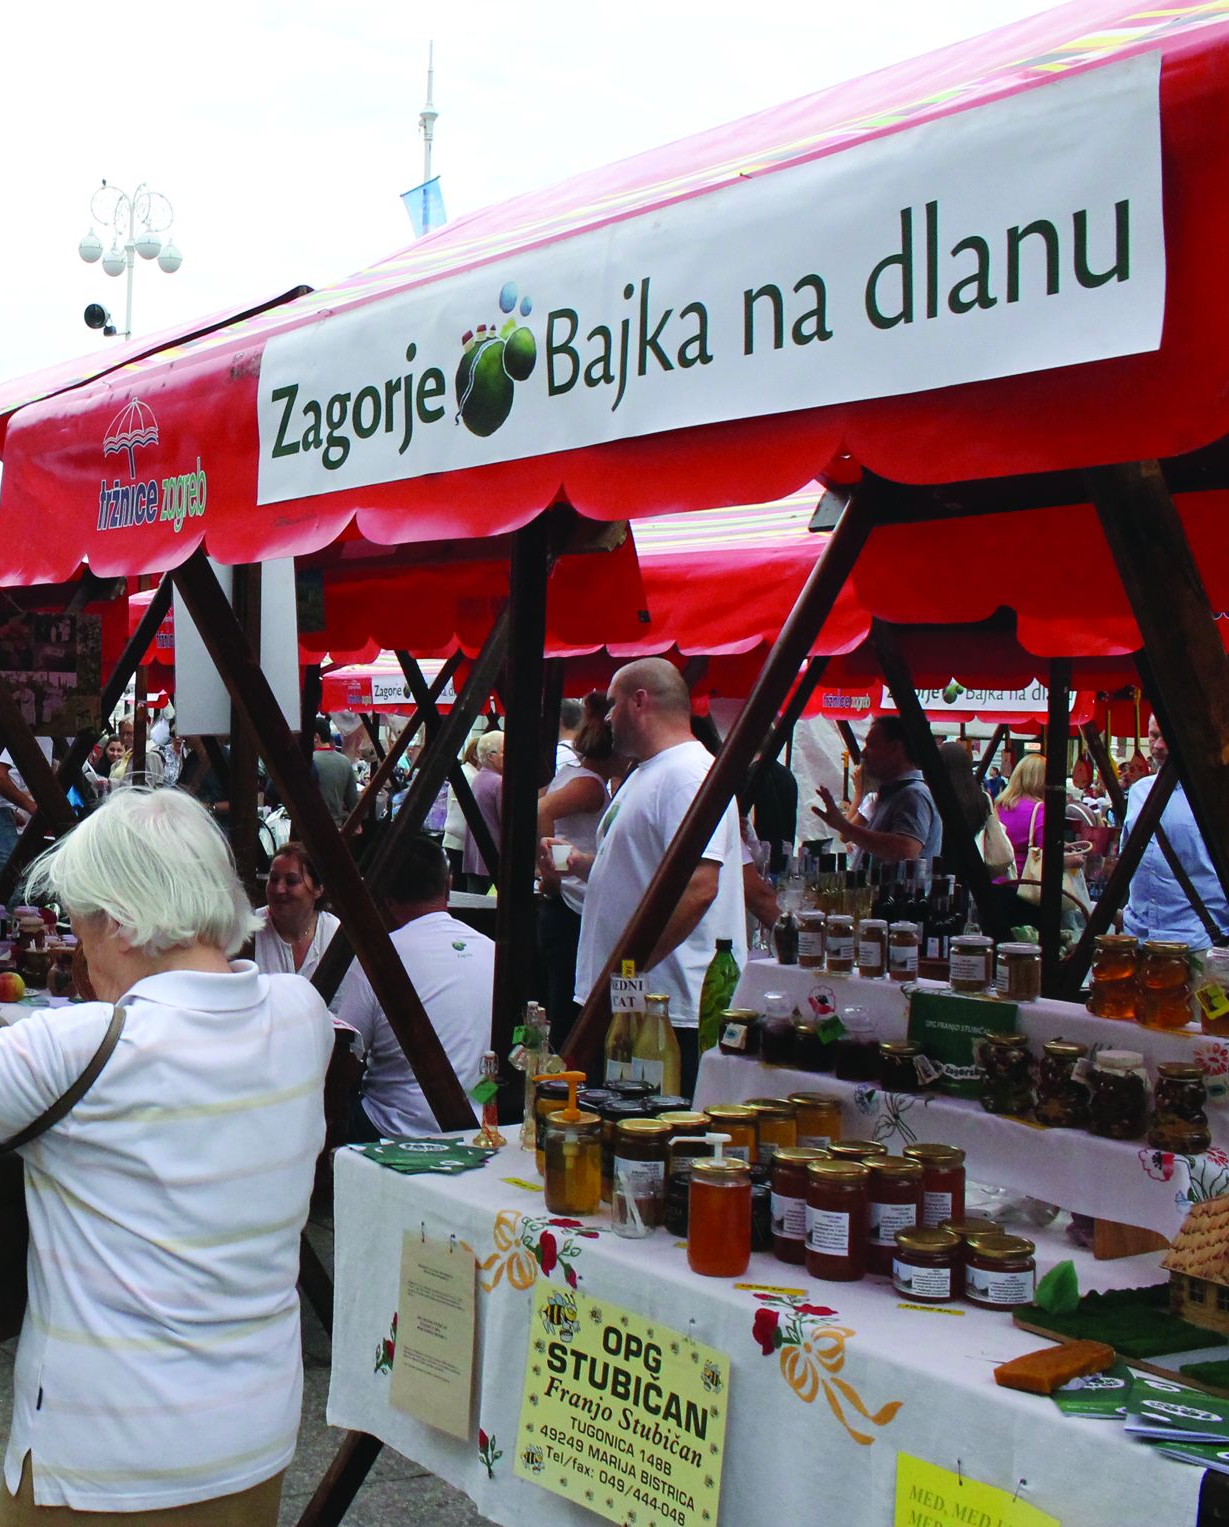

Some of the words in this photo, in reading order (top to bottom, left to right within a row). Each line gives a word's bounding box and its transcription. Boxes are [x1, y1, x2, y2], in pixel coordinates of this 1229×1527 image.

[272, 342, 446, 471] Zagorje
[546, 276, 713, 412] Bajka
[744, 273, 833, 355] na
[865, 199, 1130, 330] dlanu
[97, 479, 158, 531] tržnice
[159, 456, 207, 533] zagreb
[547, 1342, 708, 1440] STUBIČAN
[602, 1325, 662, 1374] OPG
[544, 1376, 613, 1421] Franjo
[618, 1407, 703, 1468] Stubičan
[570, 1416, 634, 1457] TUGONICA
[639, 1449, 672, 1476] 148B
[540, 1425, 584, 1452] 49249
[588, 1445, 636, 1479] MARIJA
[640, 1470, 695, 1511] BISTRICA
[545, 1445, 594, 1478] Tel/fax:
[599, 1470, 685, 1527] 049/444-048
